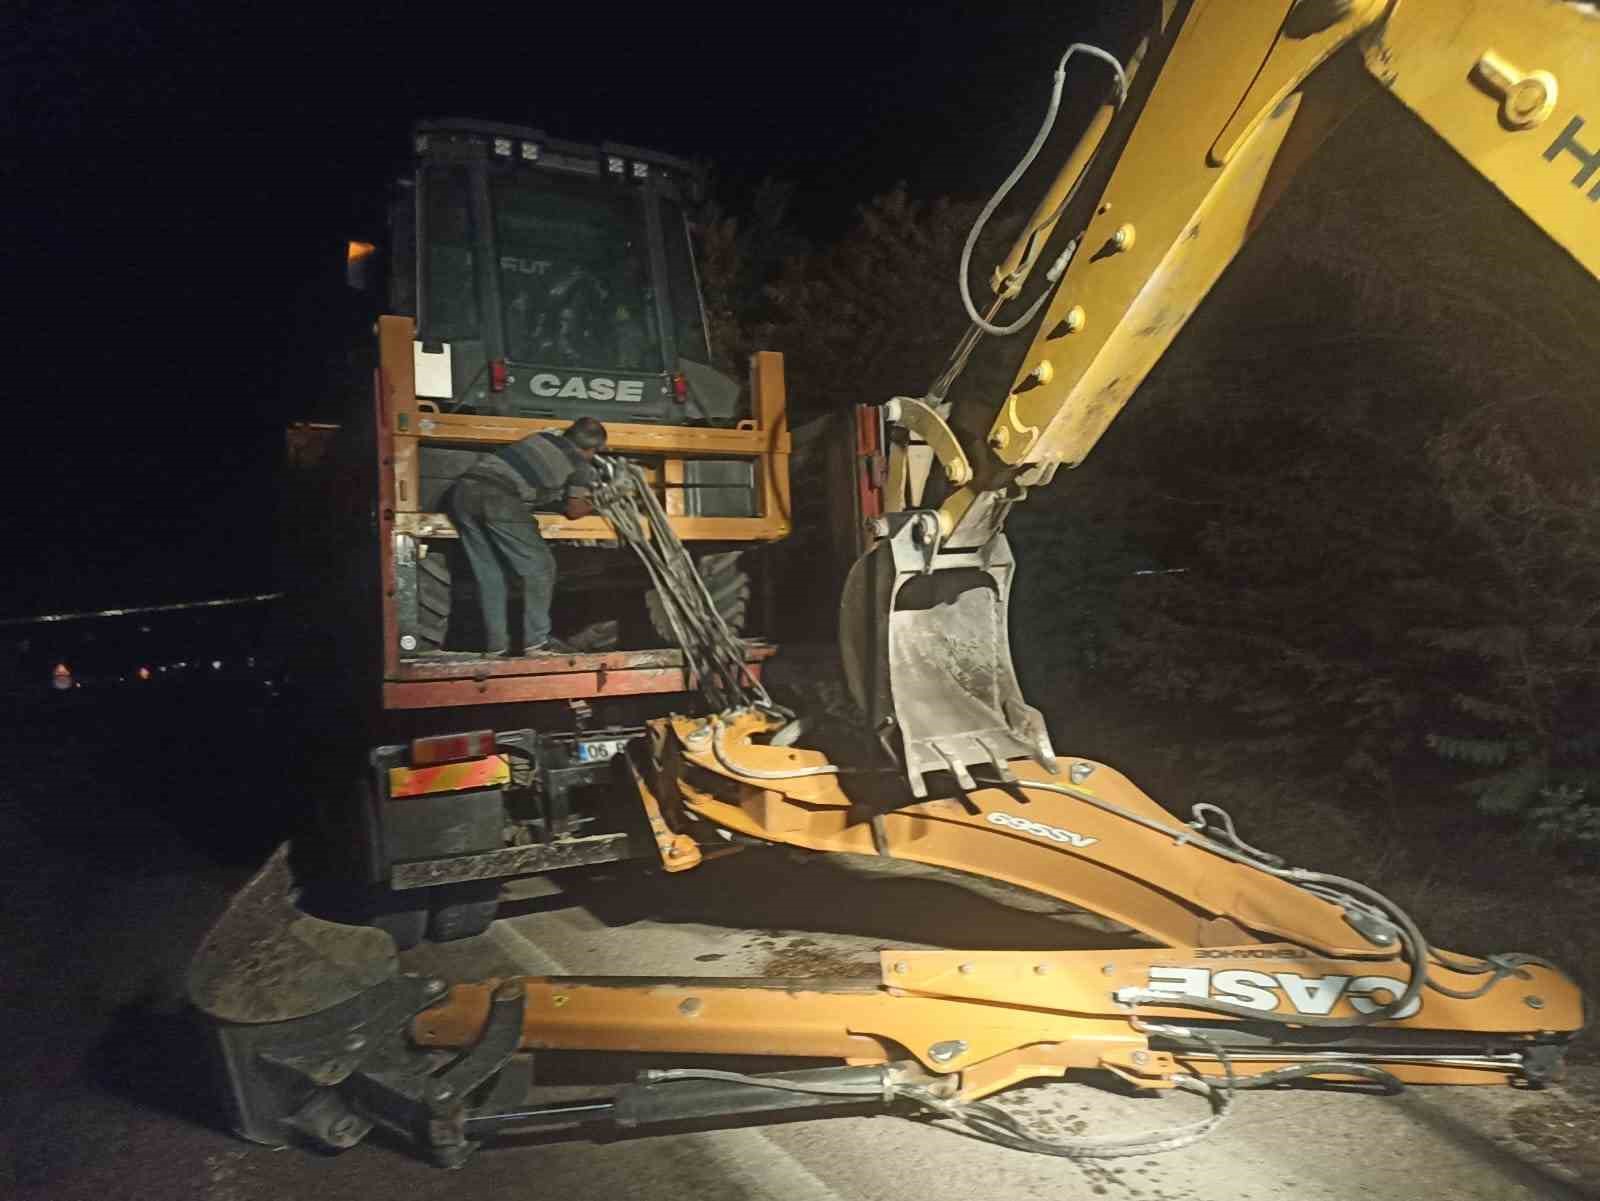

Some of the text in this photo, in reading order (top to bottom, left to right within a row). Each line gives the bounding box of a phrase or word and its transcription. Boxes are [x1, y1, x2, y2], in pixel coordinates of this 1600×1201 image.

[529, 373, 644, 402] CASE
[587, 743, 609, 758] 06
[1149, 965, 1422, 1019] CASE
